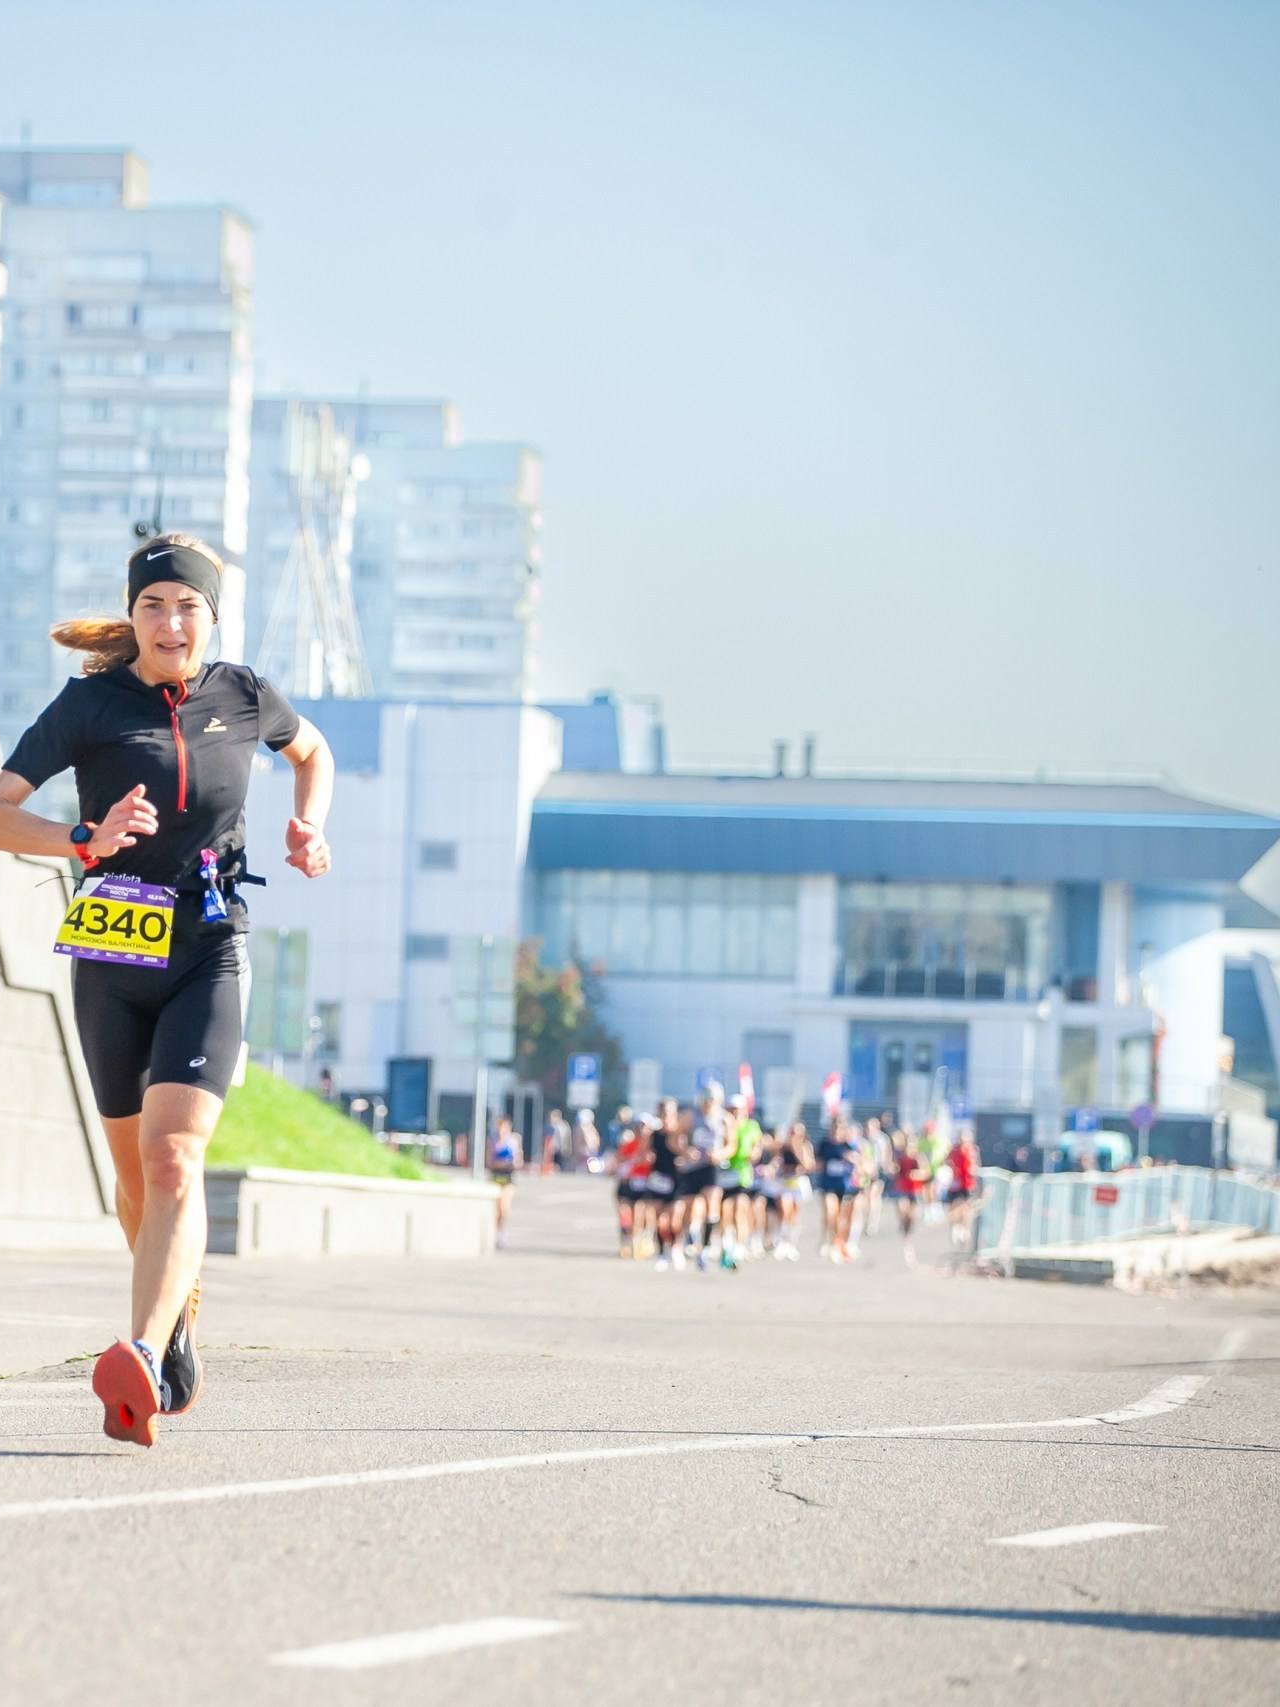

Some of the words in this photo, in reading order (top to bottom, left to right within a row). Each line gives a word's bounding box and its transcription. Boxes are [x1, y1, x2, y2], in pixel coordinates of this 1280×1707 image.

[63, 901, 167, 943] 4340
[70, 934, 107, 945] МОРОЗЮК
[108, 939, 151, 950] ВАЛЕНТИНА
